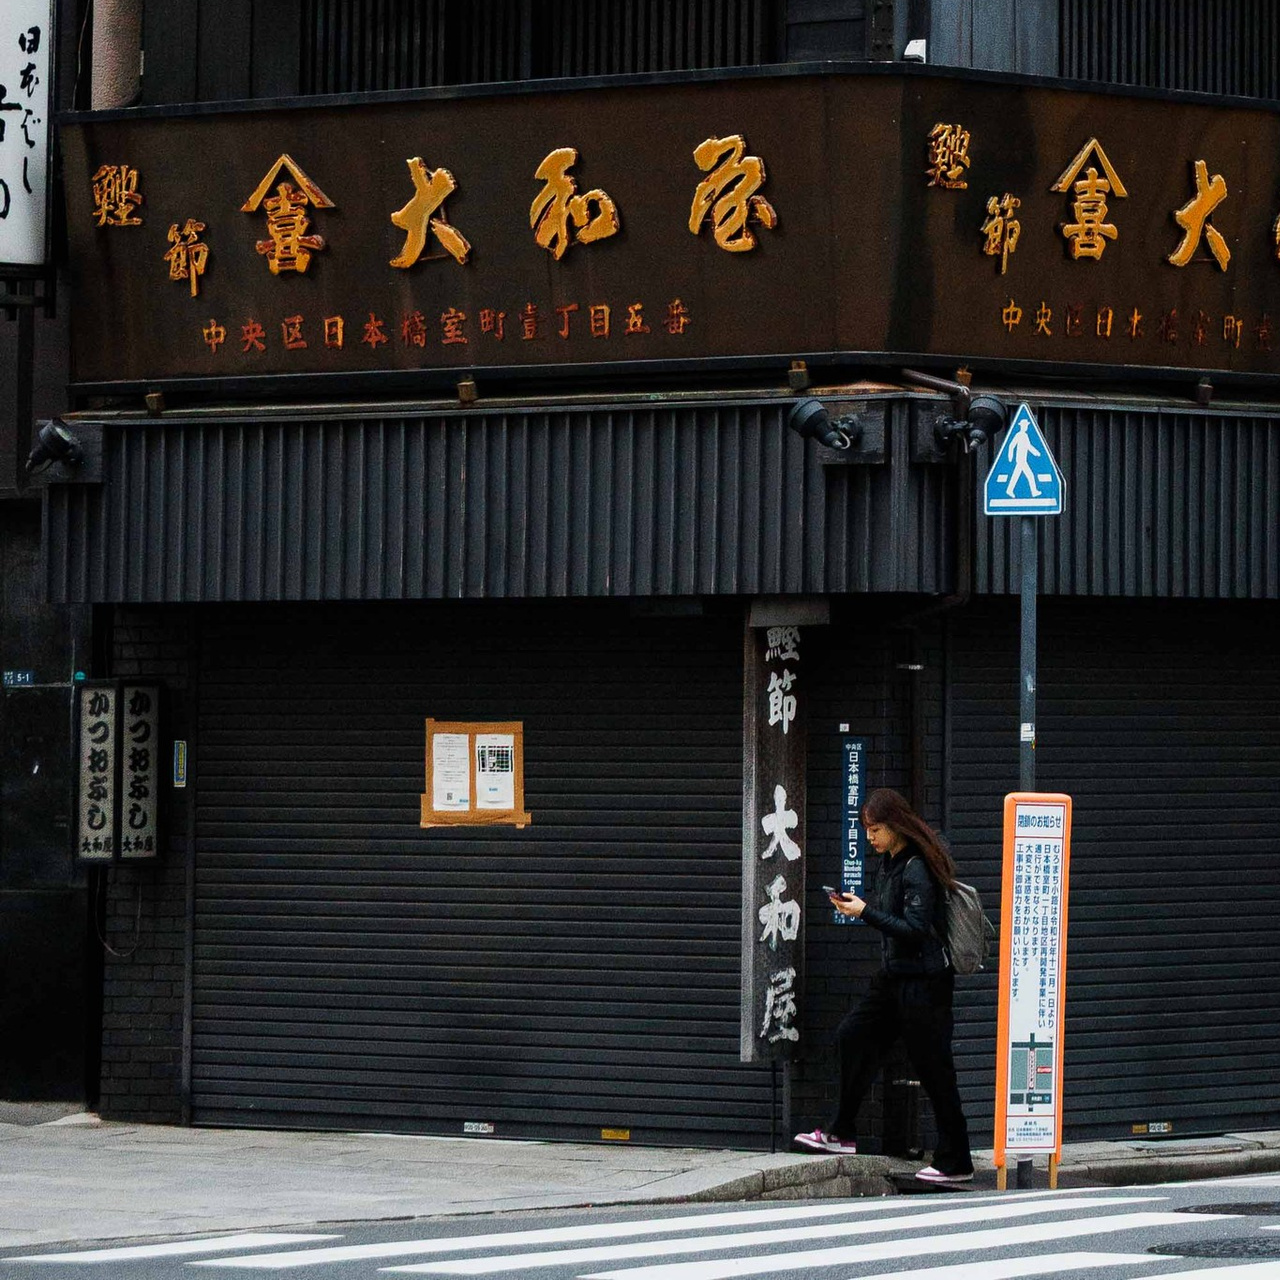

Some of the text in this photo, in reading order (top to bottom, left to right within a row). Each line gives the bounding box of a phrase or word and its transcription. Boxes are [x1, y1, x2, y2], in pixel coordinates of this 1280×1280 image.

[388, 134, 777, 270] 大和屋
[17, 673, 30, 682] 5-1
[848, 752, 860, 840] 日本橋室町一丁目
[1017, 814, 1061, 829] 閉鎖のお知らせ
[848, 841, 858, 859] 5
[850, 886, 855, 895] 5
[758, 783, 802, 1044] 大和屋
